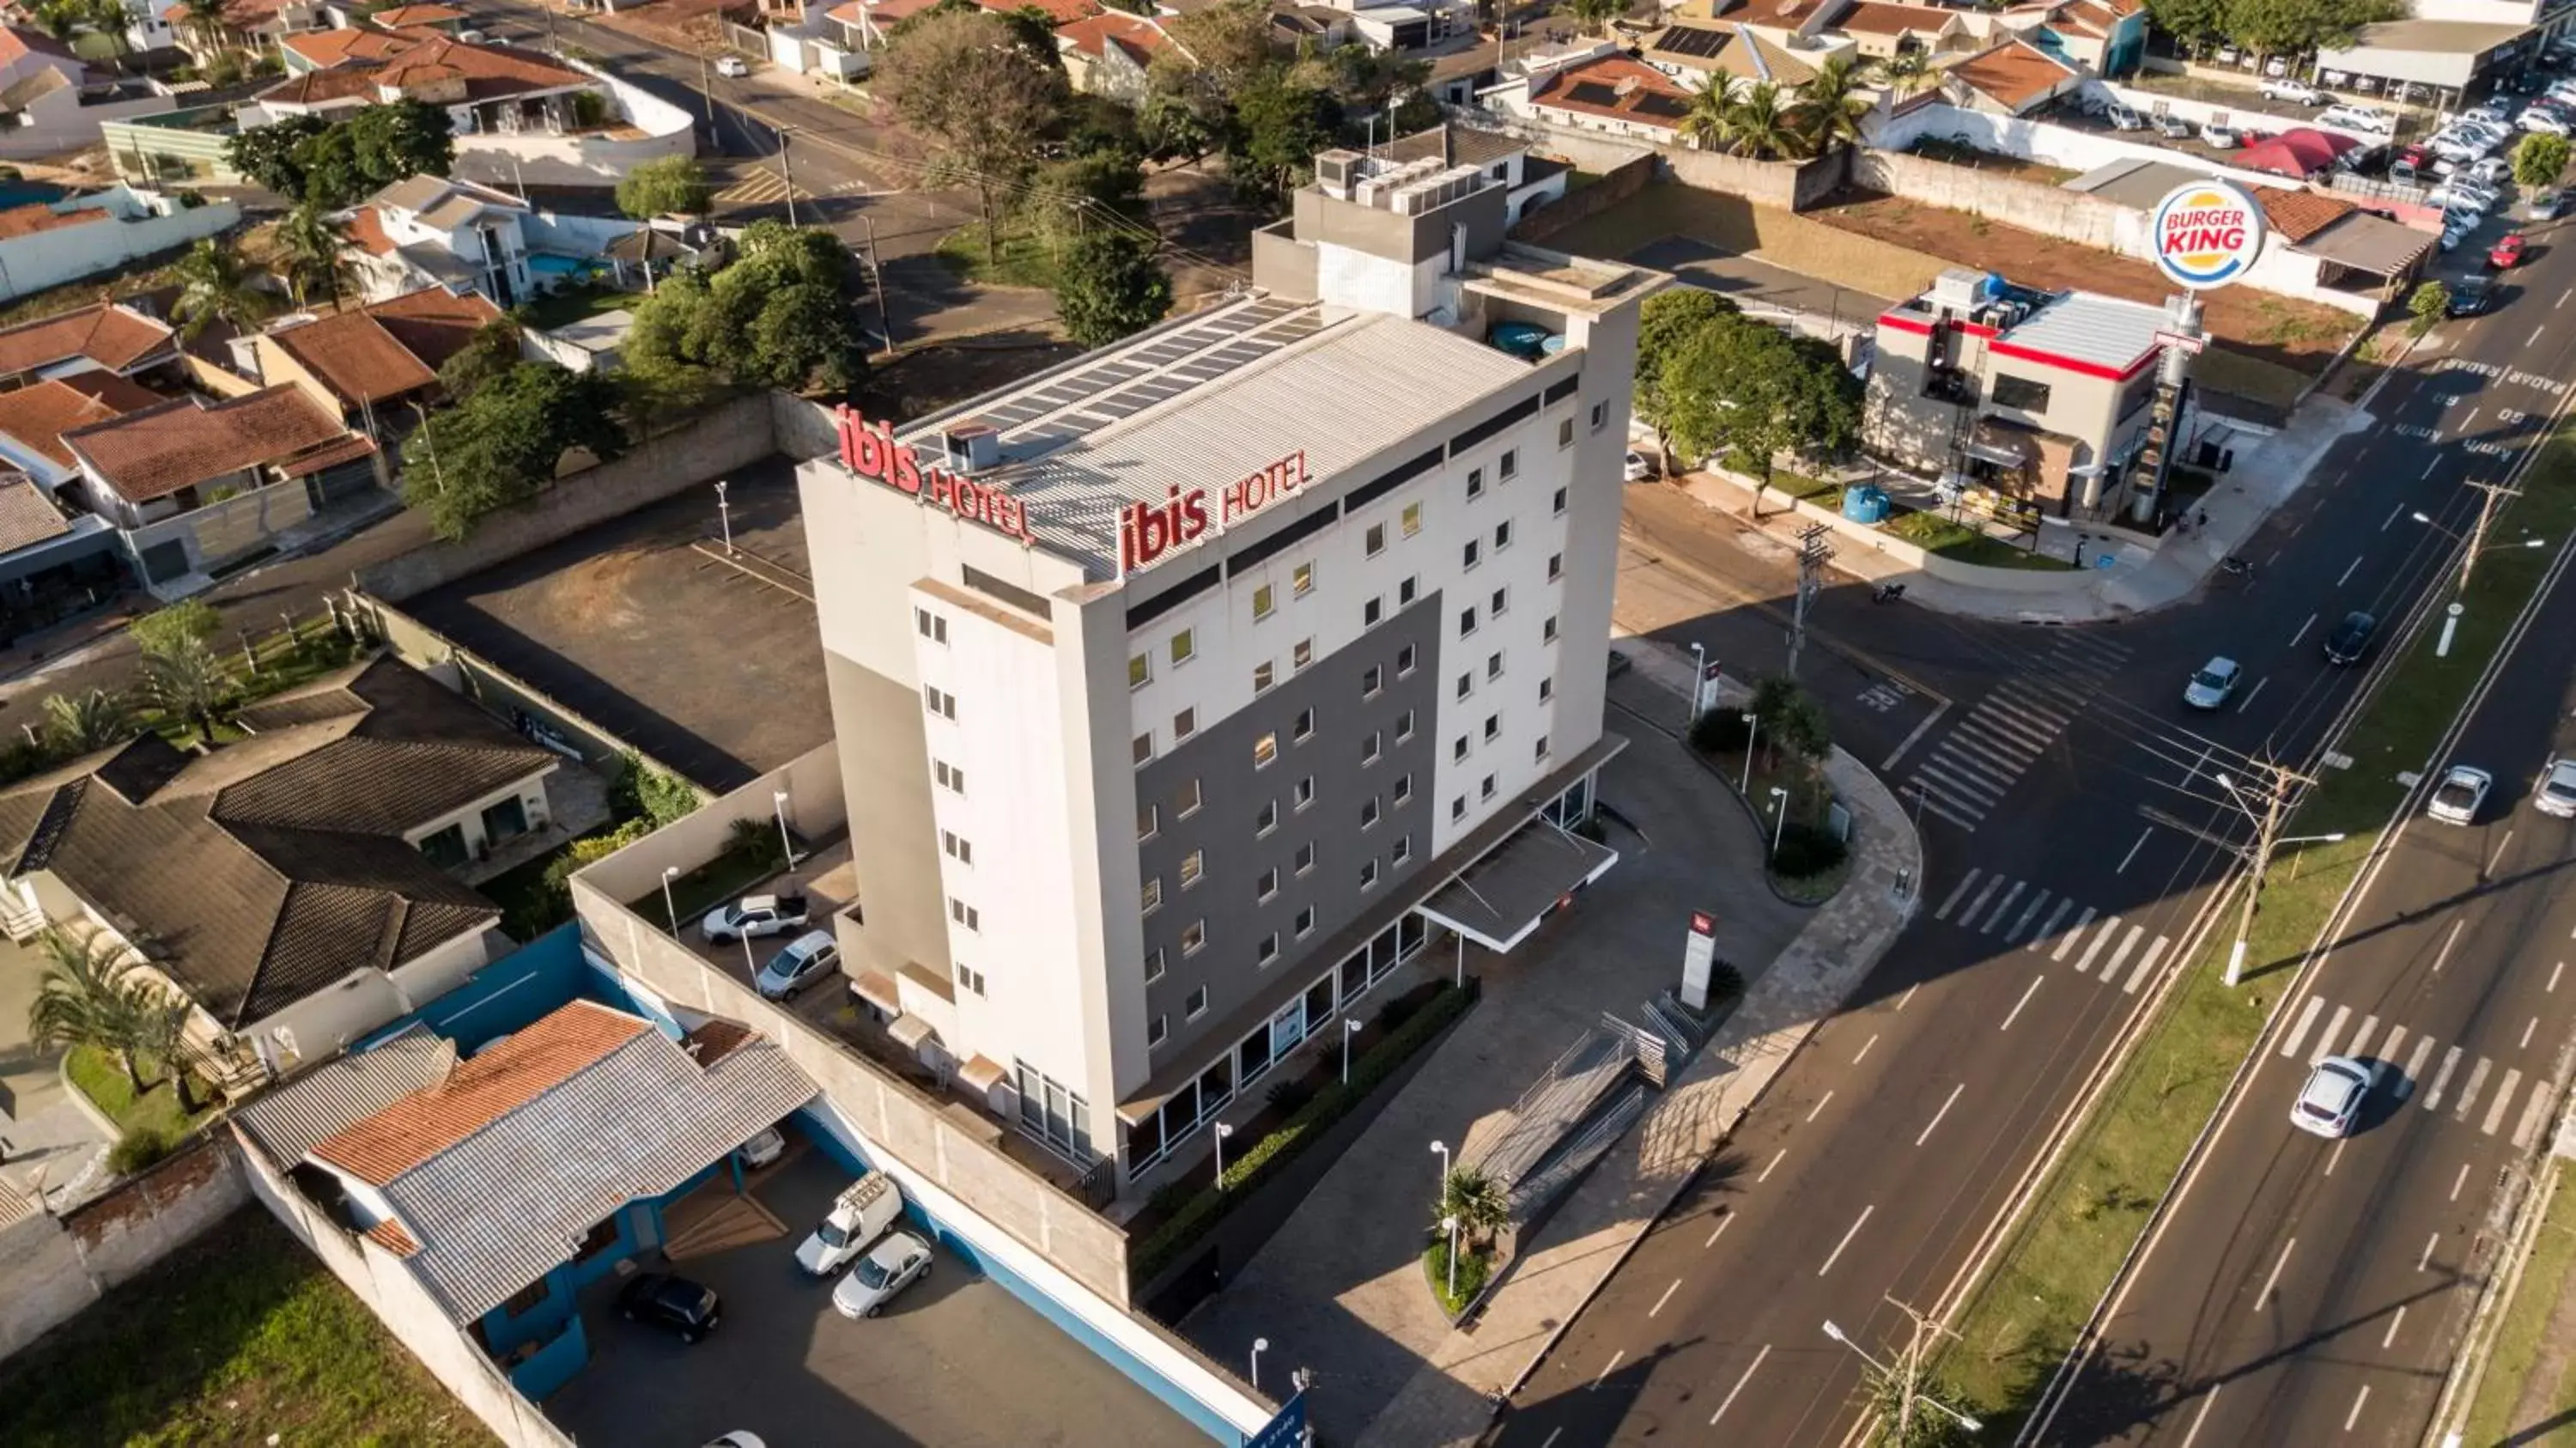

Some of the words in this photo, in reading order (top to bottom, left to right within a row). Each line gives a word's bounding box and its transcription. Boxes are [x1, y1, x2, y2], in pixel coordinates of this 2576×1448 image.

[2166, 210, 2245, 230] BURGER
[2164, 228, 2245, 254] KING
[2444, 358, 2500, 377] RADAR
[2508, 370, 2567, 395] RADAR
[835, 402, 922, 495] ibis
[930, 466, 1036, 545] HOTEL
[1121, 482, 1208, 573] ibis
[1221, 448, 1313, 523] HOTEL
